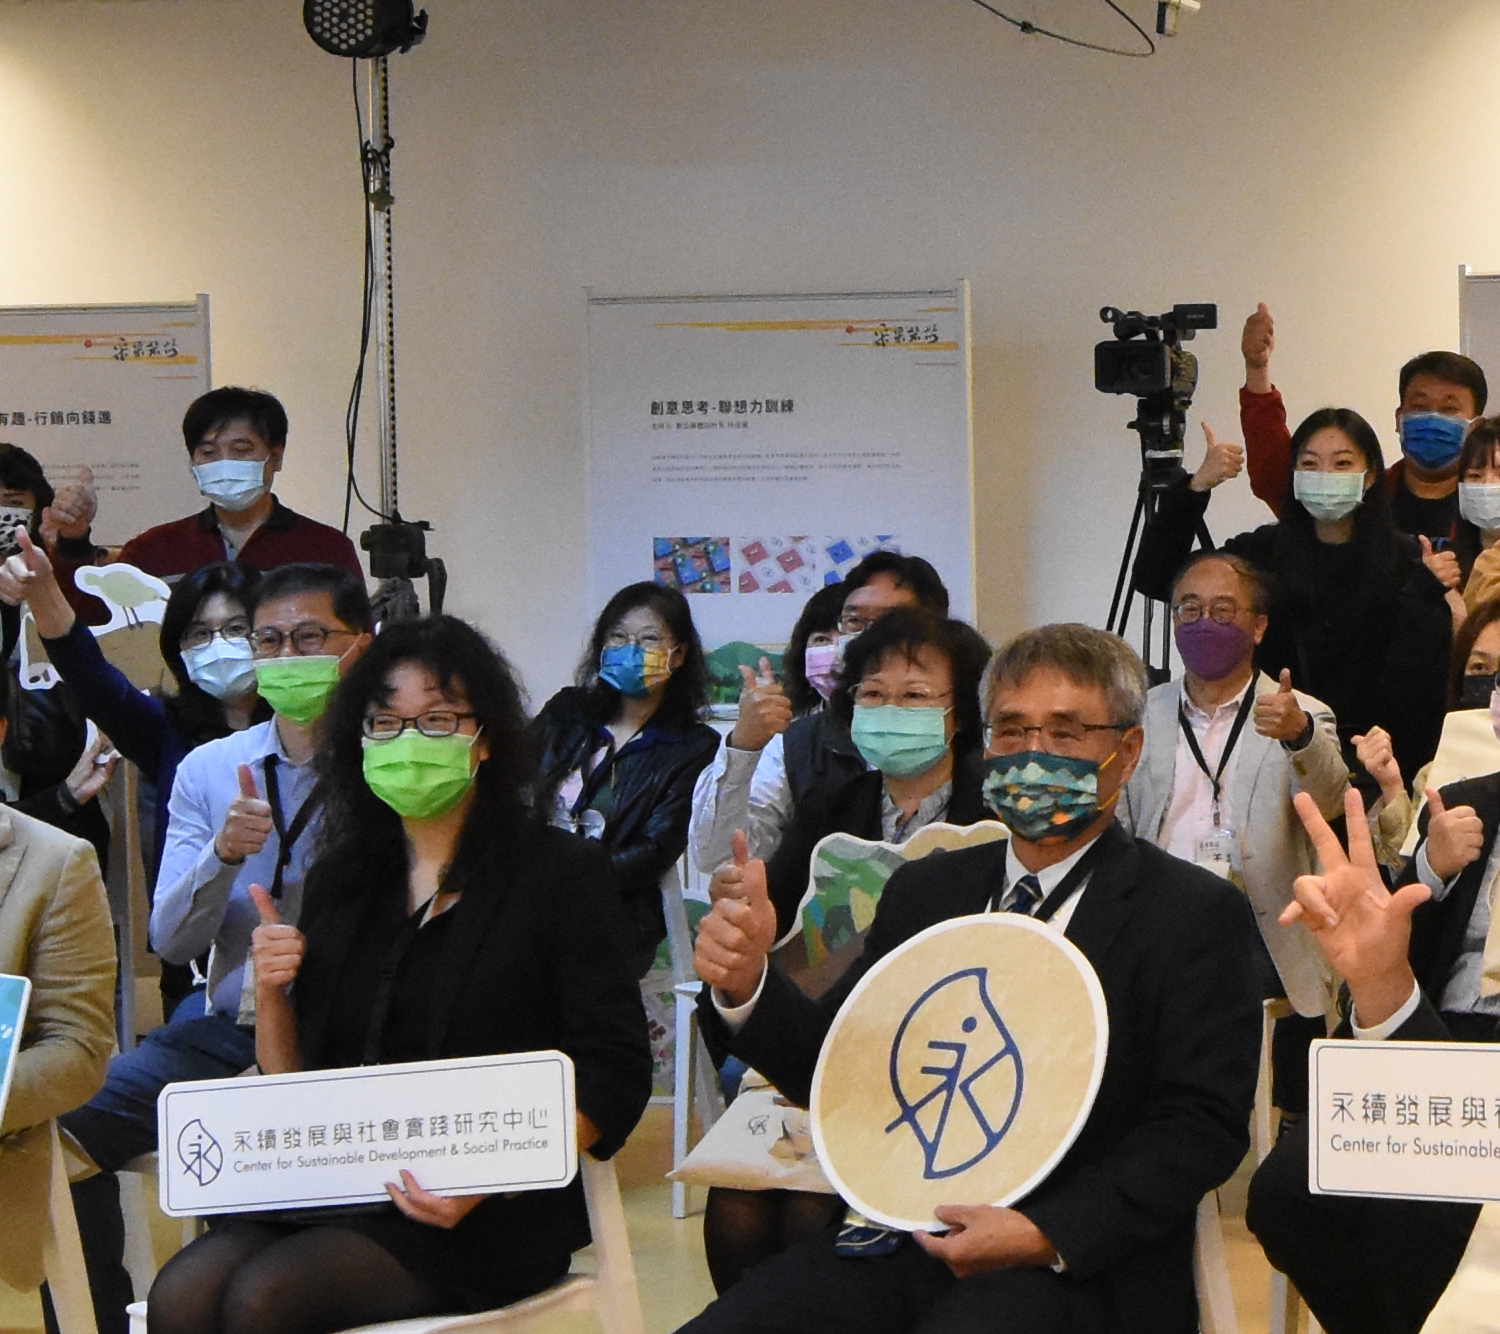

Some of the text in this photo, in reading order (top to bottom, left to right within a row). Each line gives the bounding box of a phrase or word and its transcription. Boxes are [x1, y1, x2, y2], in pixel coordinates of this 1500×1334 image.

[651, 399, 794, 415] 創意思考-聯想力訓練
[234, 1108, 548, 1152] 永續發展與社會實踐研究中心
[1330, 1134, 1381, 1154] Center
[1386, 1135, 1408, 1154] for
[234, 1136, 549, 1174] Center for Sustainable Development & Social Practice
